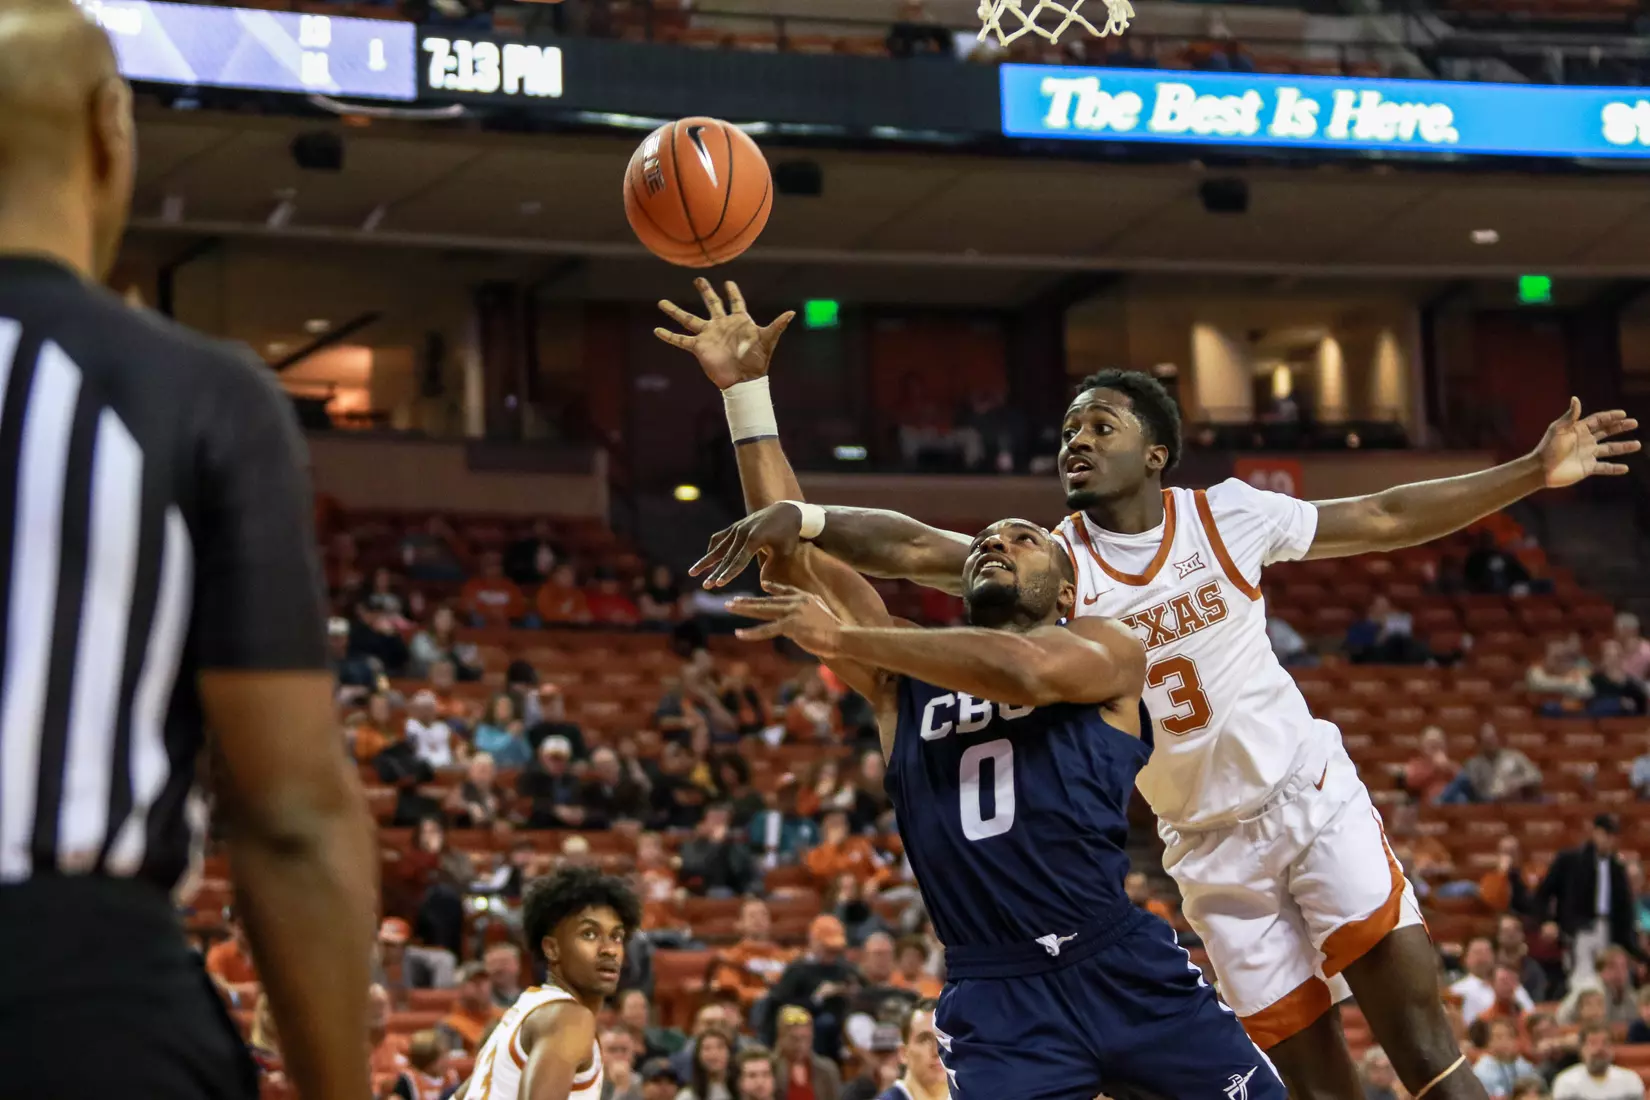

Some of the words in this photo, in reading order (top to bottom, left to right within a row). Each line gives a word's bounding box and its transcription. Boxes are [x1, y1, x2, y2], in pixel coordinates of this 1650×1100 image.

[423, 37, 500, 93] 7:13
[502, 43, 563, 98] PM
[1041, 76, 1143, 131] The
[1148, 82, 1263, 136] Best
[1268, 87, 1319, 138] Is
[1325, 89, 1459, 144] Here.
[1118, 580, 1229, 652] XAS
[1147, 654, 1213, 736] 3
[960, 738, 1015, 841] 0
